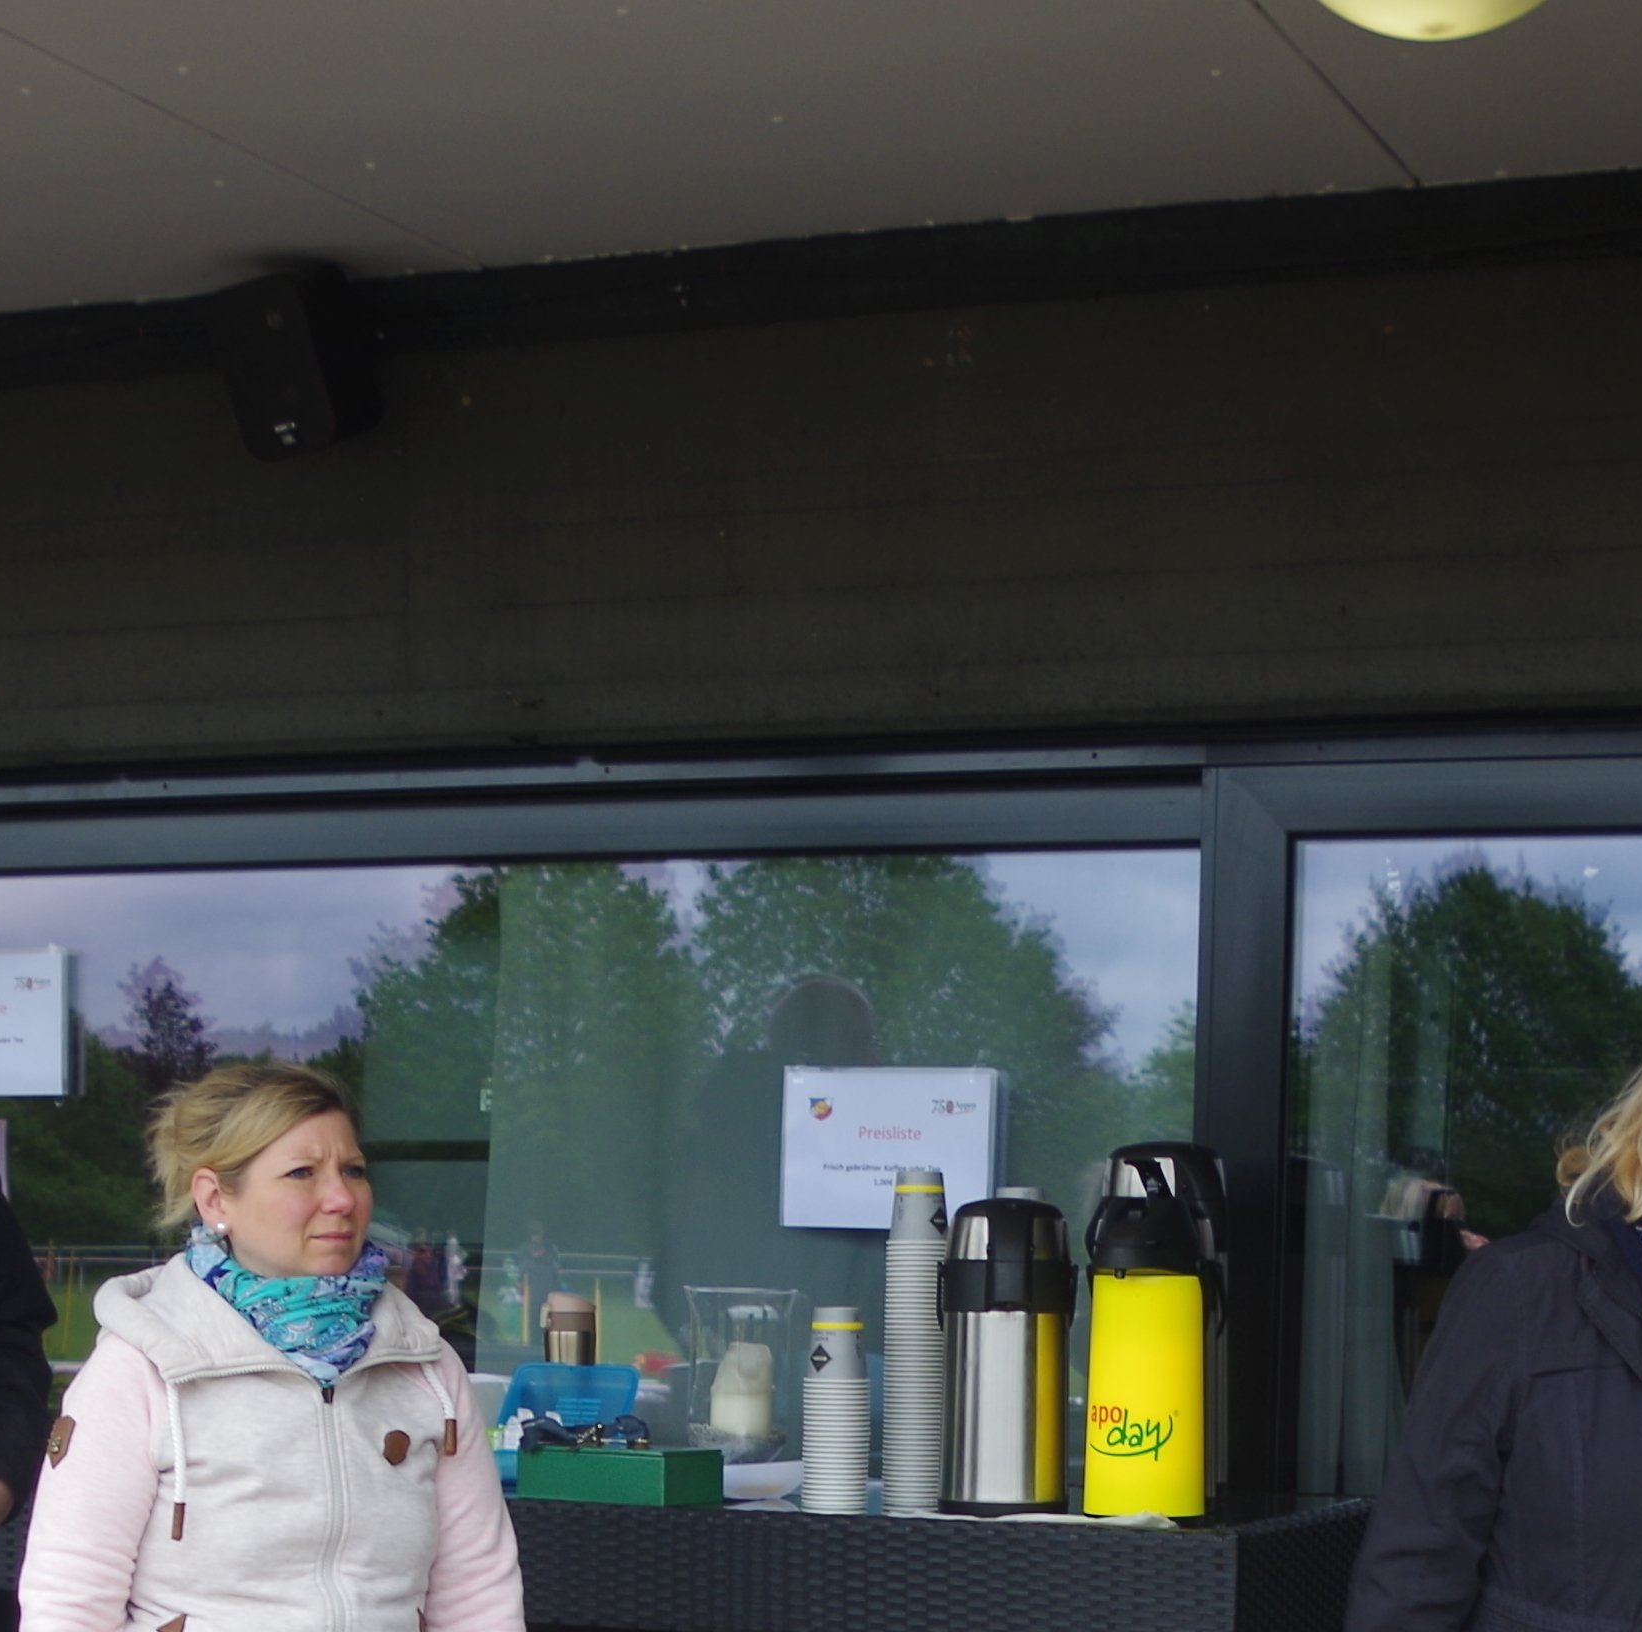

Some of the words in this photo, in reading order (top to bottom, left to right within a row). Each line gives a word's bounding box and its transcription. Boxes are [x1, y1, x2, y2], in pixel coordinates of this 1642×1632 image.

[858, 1125, 923, 1140] Preisliste
[1090, 1405, 1123, 1430] apo
[1106, 1408, 1161, 1462] day
